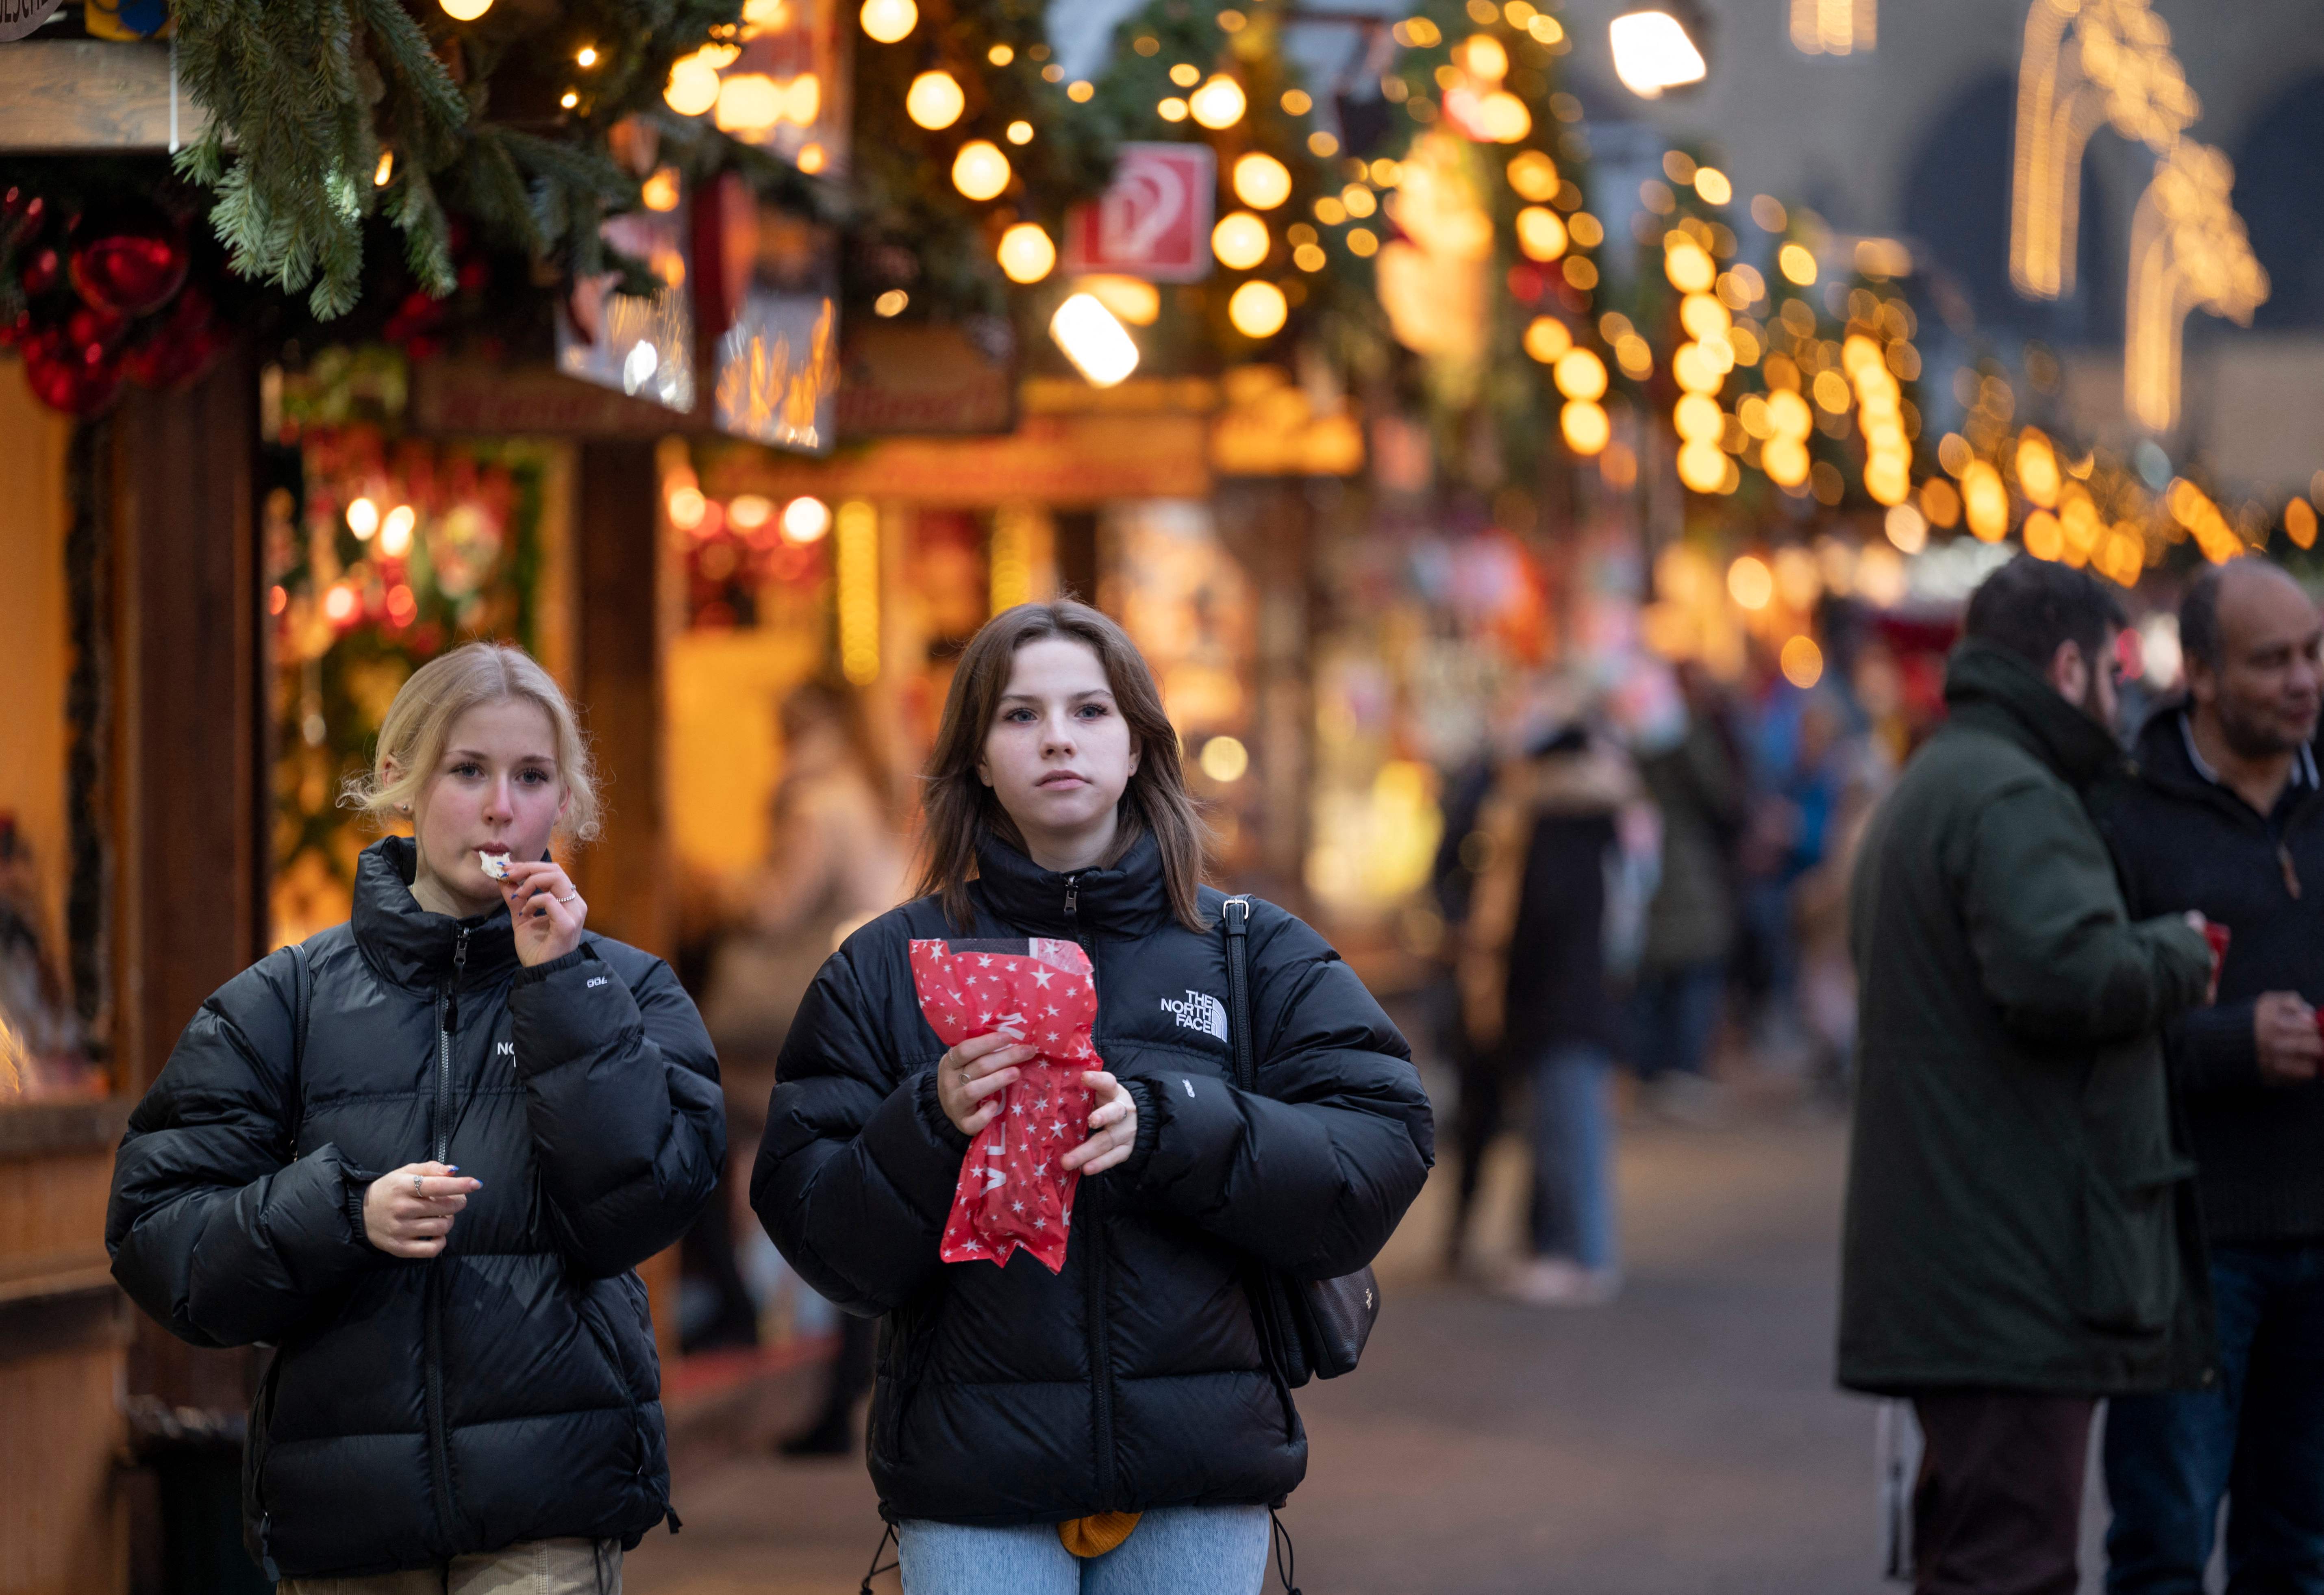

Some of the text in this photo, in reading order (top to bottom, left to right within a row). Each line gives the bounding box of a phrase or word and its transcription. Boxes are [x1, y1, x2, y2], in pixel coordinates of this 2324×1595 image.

[1161, 998, 1212, 1021] NORTH
[1185, 989, 1213, 1009] THE
[1176, 1013, 1211, 1034] FACE
